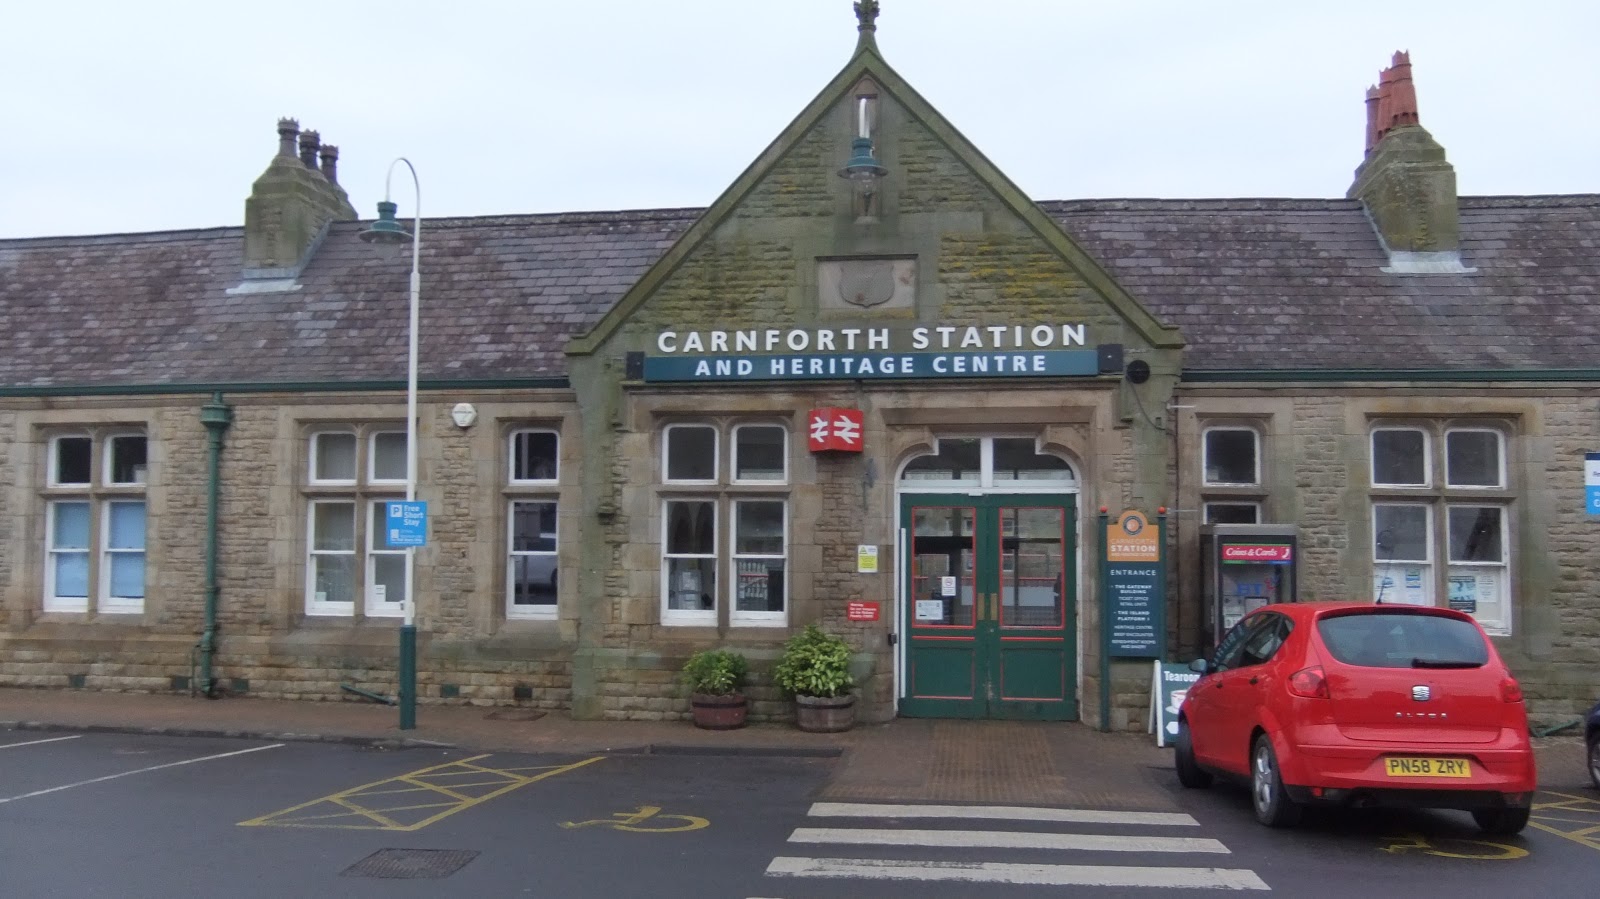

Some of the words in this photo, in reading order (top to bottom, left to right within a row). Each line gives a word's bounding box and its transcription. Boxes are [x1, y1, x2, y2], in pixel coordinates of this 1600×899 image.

[657, 328, 889, 353] CARNFORTH
[912, 324, 1085, 349] STATION
[695, 359, 753, 376] AND
[770, 357, 914, 375] HERITAGE
[932, 355, 1046, 373] CENTRE
[1225, 547, 1247, 556] Coins
[1255, 547, 1278, 556] Cards
[1390, 759, 1431, 774] PN58
[1436, 760, 1465, 775] ZRY
